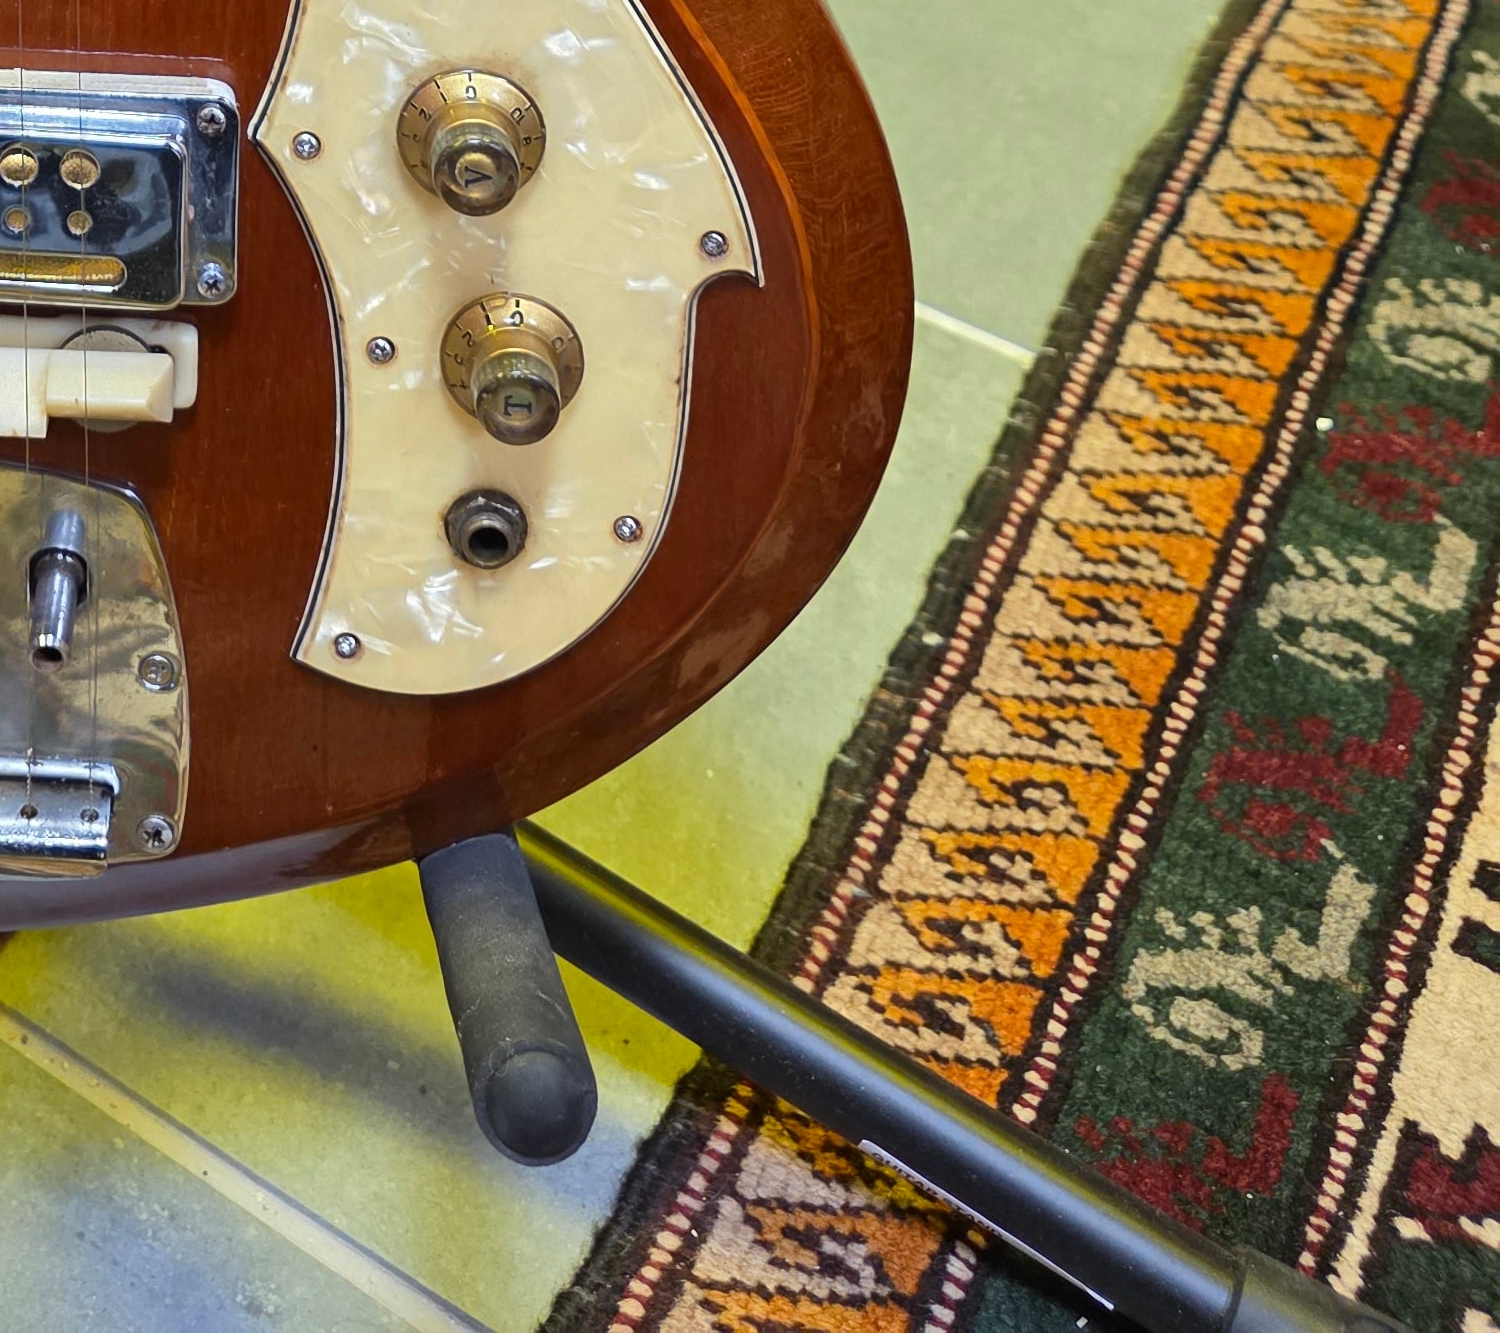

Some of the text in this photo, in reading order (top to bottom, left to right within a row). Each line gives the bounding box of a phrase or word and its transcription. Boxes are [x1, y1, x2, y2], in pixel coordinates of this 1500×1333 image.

[465, 85, 477, 100] 0
[464, 165, 493, 189] V
[509, 310, 524, 327] 0
[503, 395, 533, 417] T
